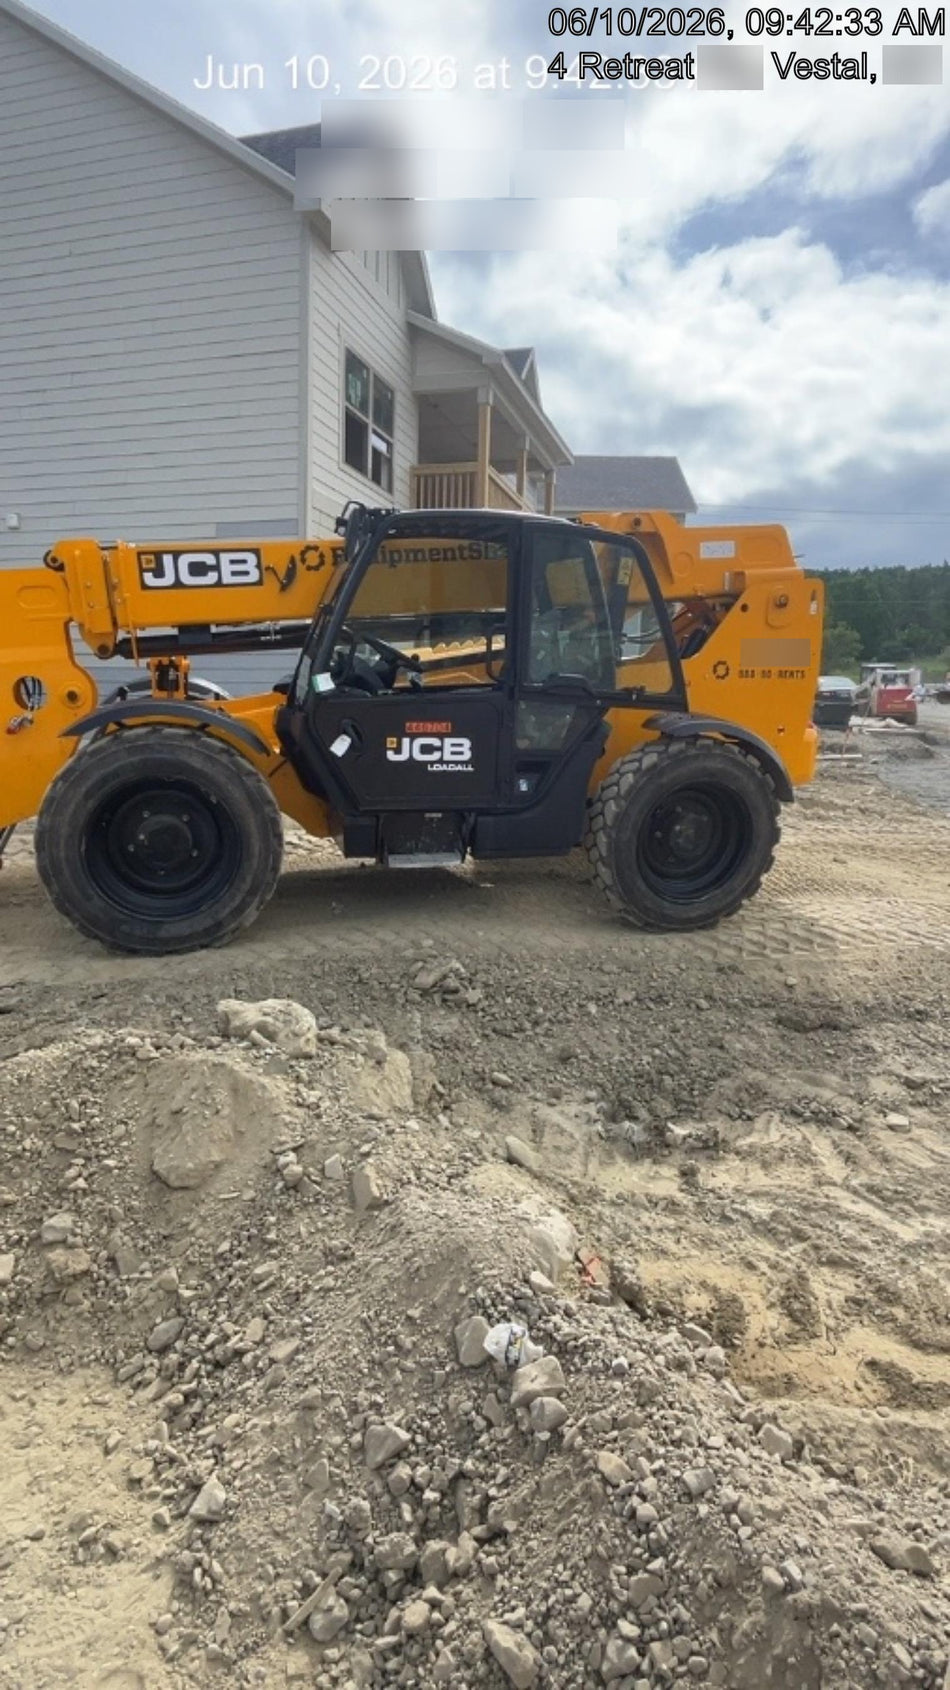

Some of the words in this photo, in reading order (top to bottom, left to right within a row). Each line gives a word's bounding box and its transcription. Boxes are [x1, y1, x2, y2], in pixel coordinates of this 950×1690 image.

[141, 552, 260, 587] JCB
[386, 737, 472, 761] JCB
[427, 763, 474, 772] LOADALL
